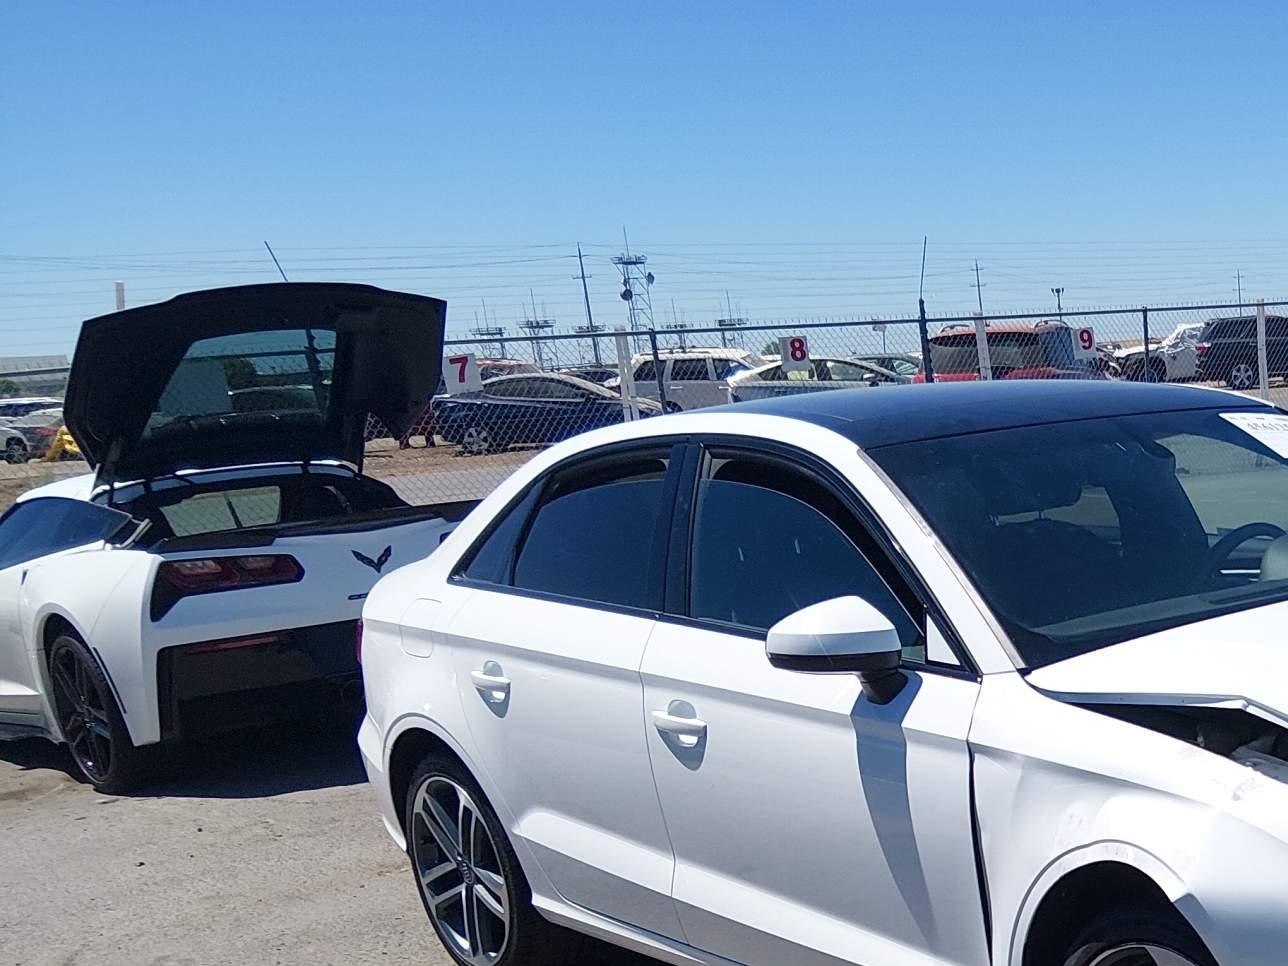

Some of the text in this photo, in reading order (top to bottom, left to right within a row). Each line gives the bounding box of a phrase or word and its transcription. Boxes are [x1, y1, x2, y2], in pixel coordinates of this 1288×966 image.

[790, 338, 806, 362] 8
[1079, 329, 1093, 350] 9
[449, 356, 469, 383] 7
